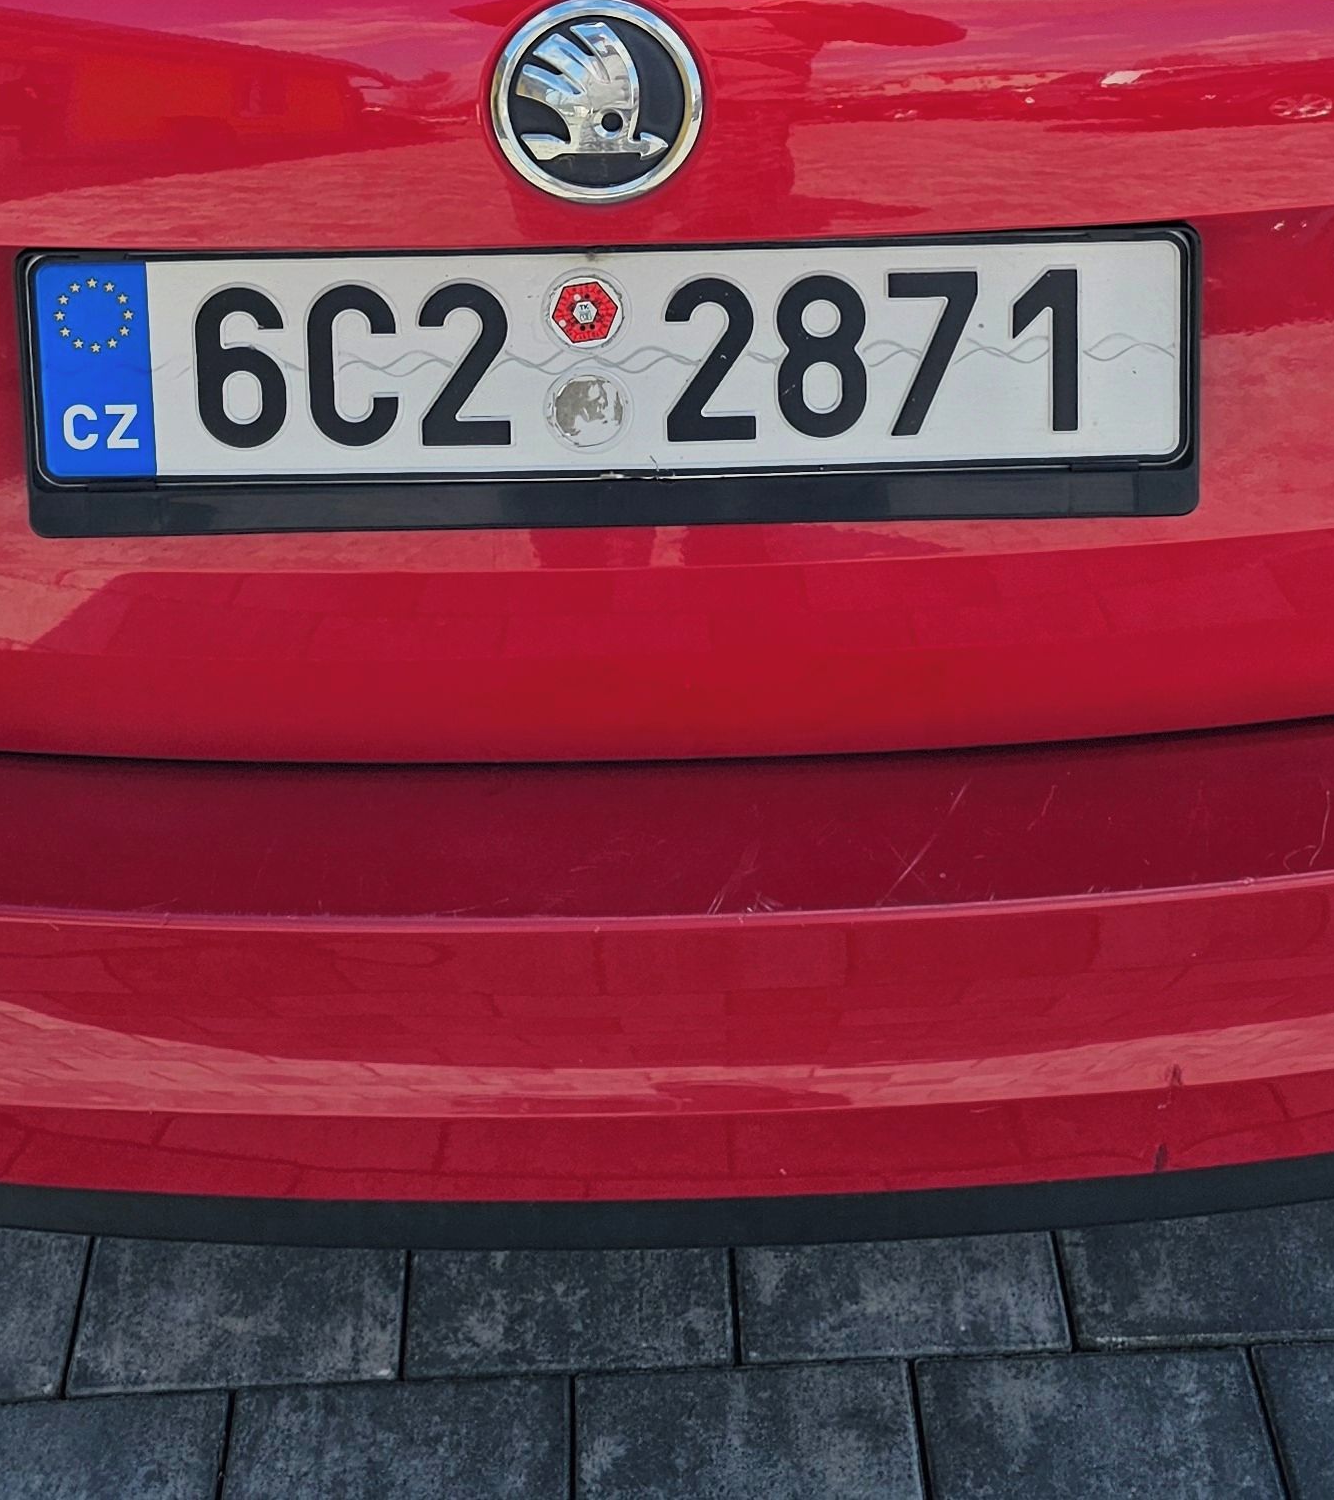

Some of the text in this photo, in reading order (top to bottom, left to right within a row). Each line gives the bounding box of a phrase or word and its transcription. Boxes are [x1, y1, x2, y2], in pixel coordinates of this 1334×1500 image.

[193, 268, 1081, 450] 6C2 2871
[62, 403, 141, 451] CZ
